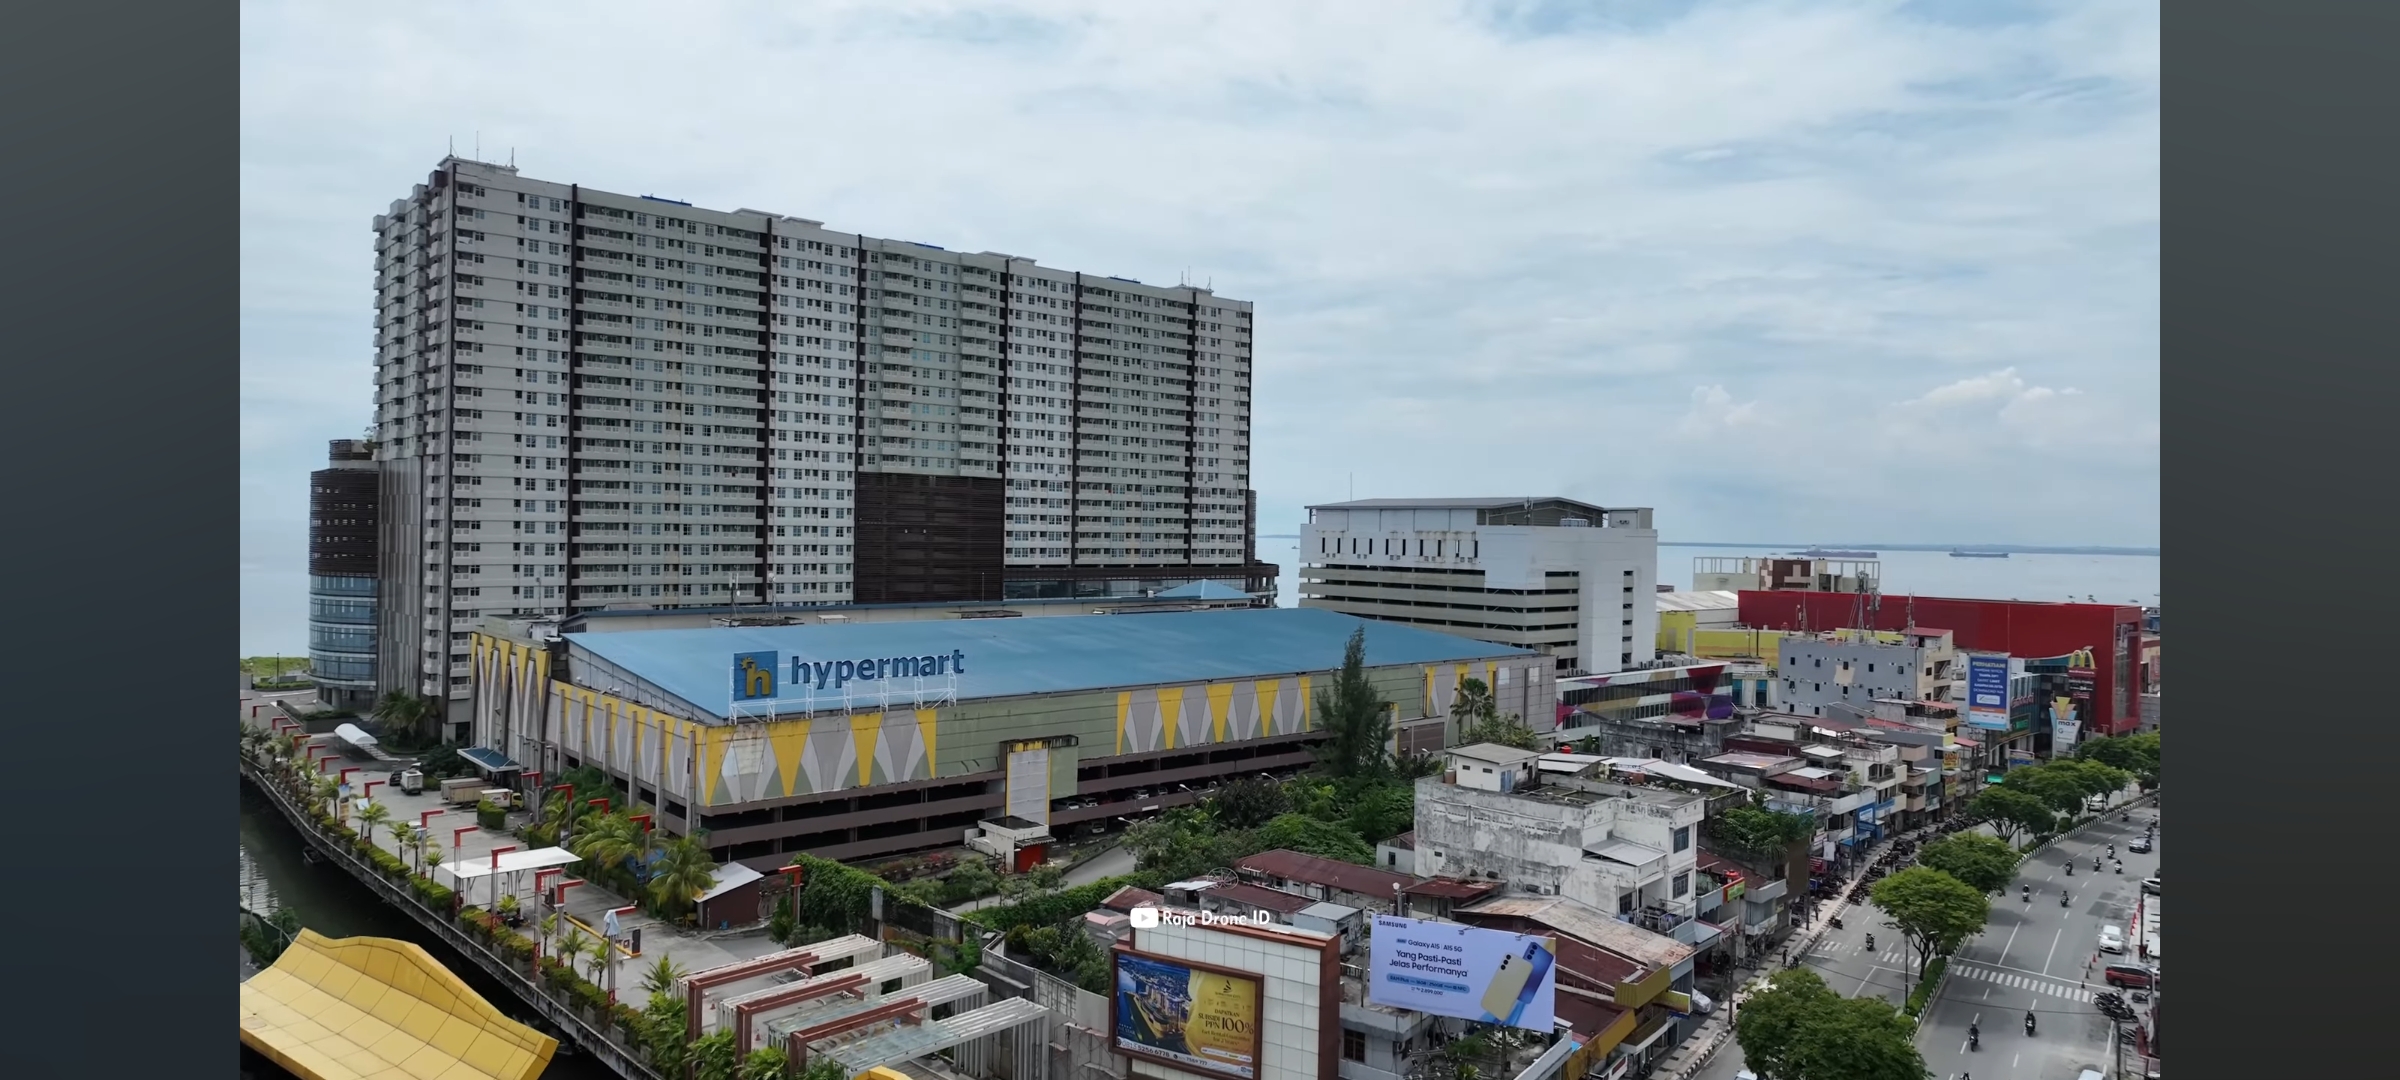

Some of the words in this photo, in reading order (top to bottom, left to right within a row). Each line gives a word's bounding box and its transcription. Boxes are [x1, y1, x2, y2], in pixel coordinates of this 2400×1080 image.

[792, 650, 964, 689] hypermart
[1379, 920, 1407, 929] SAMSUNG
[1408, 940, 1430, 949] Galaxy
[1396, 950, 1416, 961] Yang
[1418, 953, 1461, 966] Pasti-Pasti
[1389, 959, 1410, 968] Jelas
[1198, 1013, 1220, 1021] SUBSIDI
[1215, 1009, 1239, 1017] DAPATKAN
[1206, 1021, 1220, 1029] PPN
[1222, 1017, 1253, 1034] 100%
